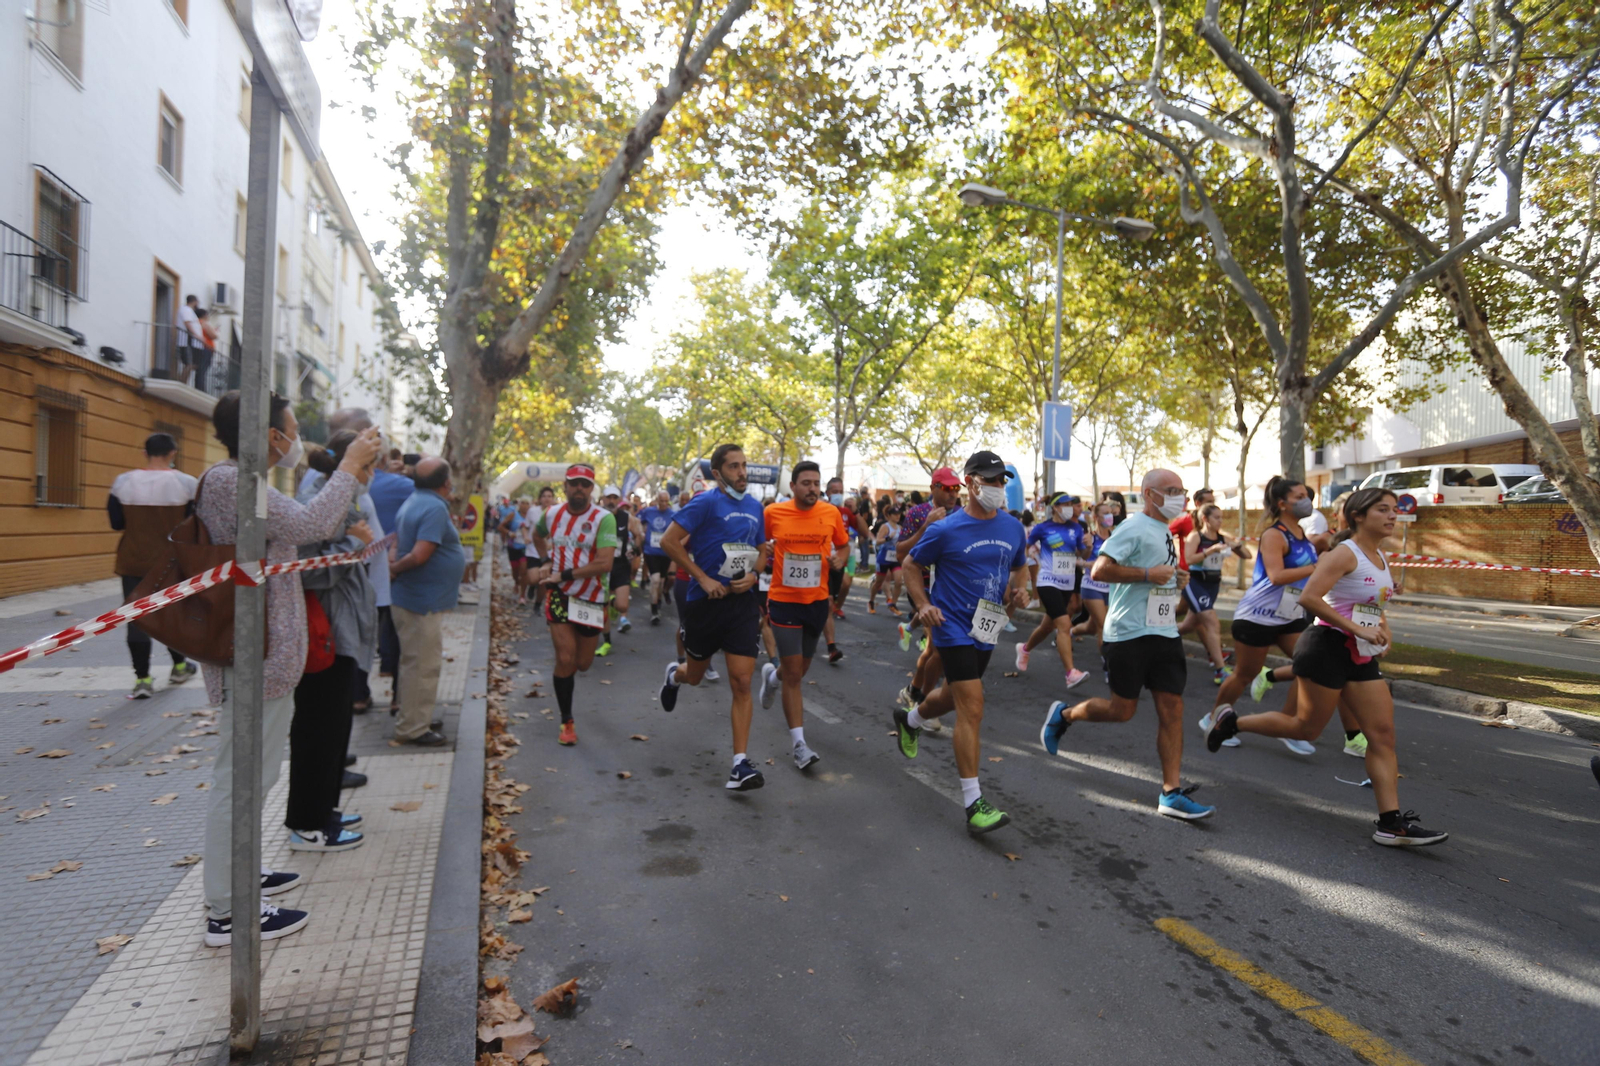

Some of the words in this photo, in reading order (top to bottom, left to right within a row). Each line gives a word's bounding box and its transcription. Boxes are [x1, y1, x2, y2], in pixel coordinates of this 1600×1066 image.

[730, 557, 746, 569] 565
[789, 566, 809, 579] 238
[577, 610, 589, 621] 89
[1158, 603, 1170, 616] 69
[978, 617, 997, 633] 357
